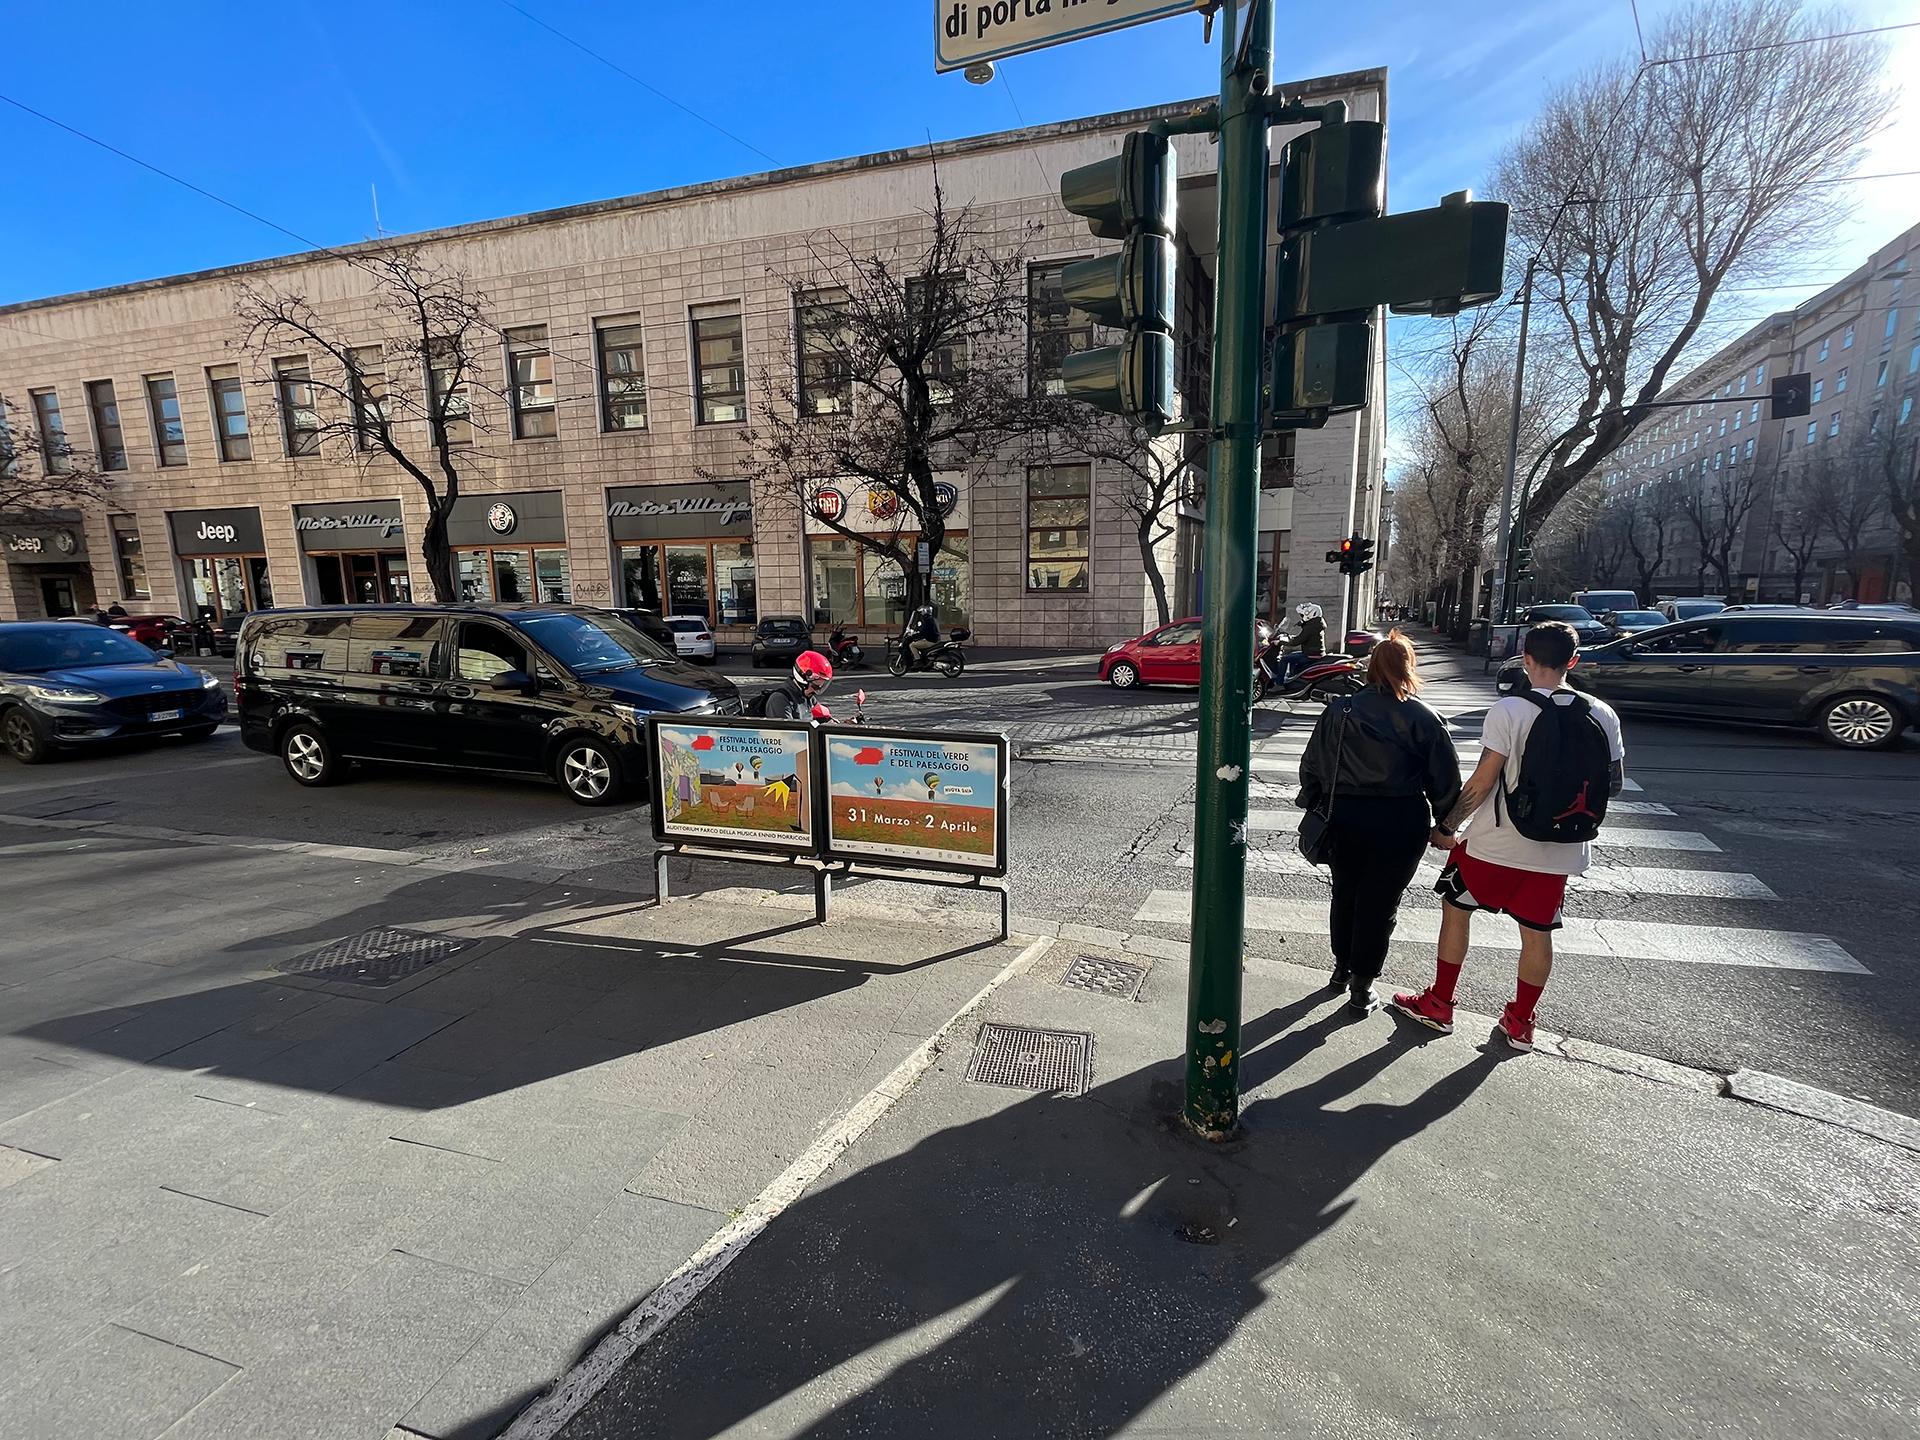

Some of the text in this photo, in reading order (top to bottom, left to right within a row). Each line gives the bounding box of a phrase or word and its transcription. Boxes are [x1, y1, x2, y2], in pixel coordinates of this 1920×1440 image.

[945, 3, 967, 38] di
[608, 500, 675, 517] Motor
[670, 497, 753, 526] Village
[818, 497, 838, 514] FIAT
[197, 521, 235, 542] Jeep
[296, 516, 346, 530] Motor
[342, 514, 404, 538] Village
[719, 736, 782, 746] FESTIVAL DEL VERDE
[726, 745, 739, 753] DEL
[740, 746, 783, 755] PAESAGGIO
[889, 748, 969, 761] FESTIVAL DEL VERDE
[890, 759, 969, 772] E DEL PAESAGGIO
[848, 808, 867, 823] 31
[874, 813, 911, 827] Marzo
[925, 814, 935, 829] 2
[940, 820, 978, 833] Aprile
[666, 824, 700, 832] AUDITORIUM
[777, 833, 810, 842] MORRICONE
